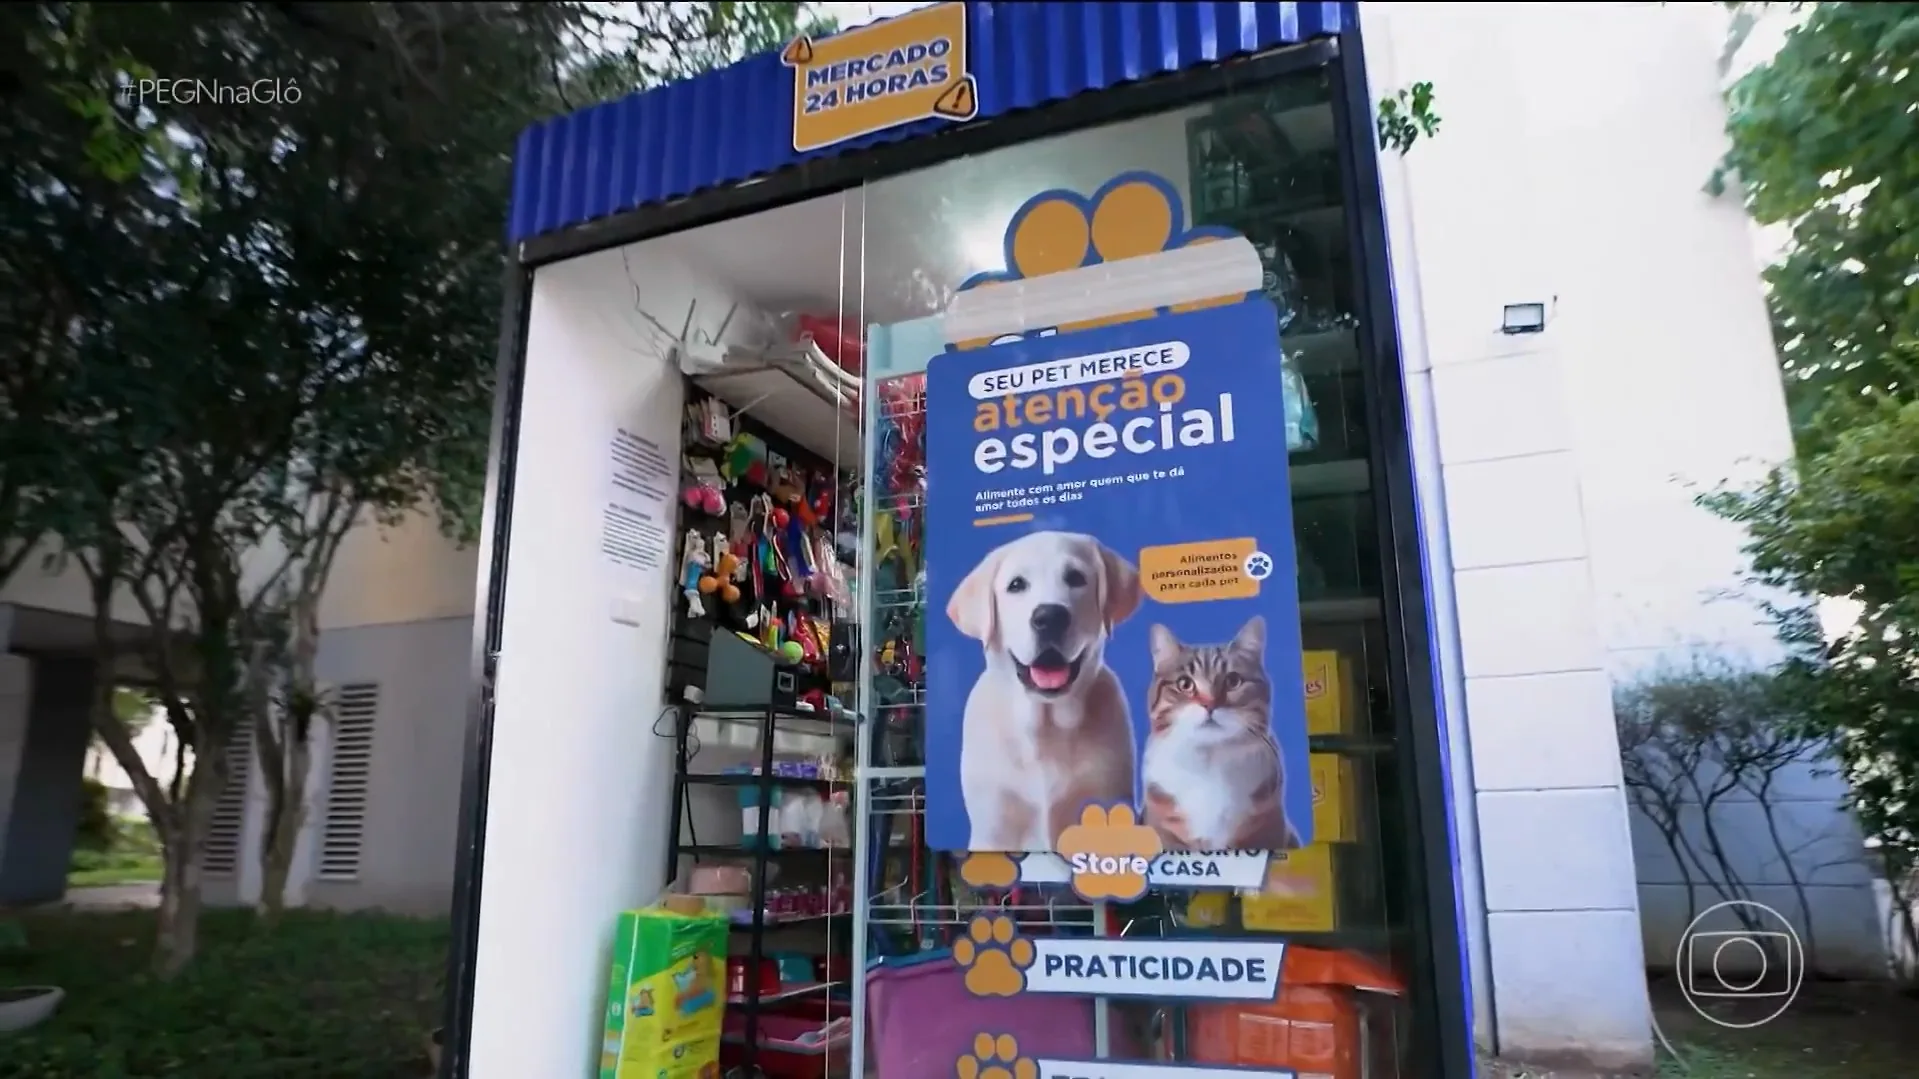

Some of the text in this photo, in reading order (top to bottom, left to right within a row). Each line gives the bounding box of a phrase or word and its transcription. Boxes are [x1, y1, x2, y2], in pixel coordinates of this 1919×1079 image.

[807, 39, 950, 88] MERCADO
[805, 64, 949, 114] 24 HORAS
[983, 347, 1173, 393] SEU PET MERECE
[973, 369, 1186, 432] atenção
[973, 392, 1235, 475] especial
[975, 466, 1185, 501] Alimente com amor quem que te dá
[975, 491, 1083, 512] amor todos os dias
[1151, 564, 1239, 580] personalizados
[1179, 552, 1238, 564] Alimentos
[1160, 576, 1239, 592] para cada pet
[1071, 852, 1149, 875] Store
[1161, 860, 1220, 877] CASA
[1045, 953, 1267, 983] PRATICIDADE
